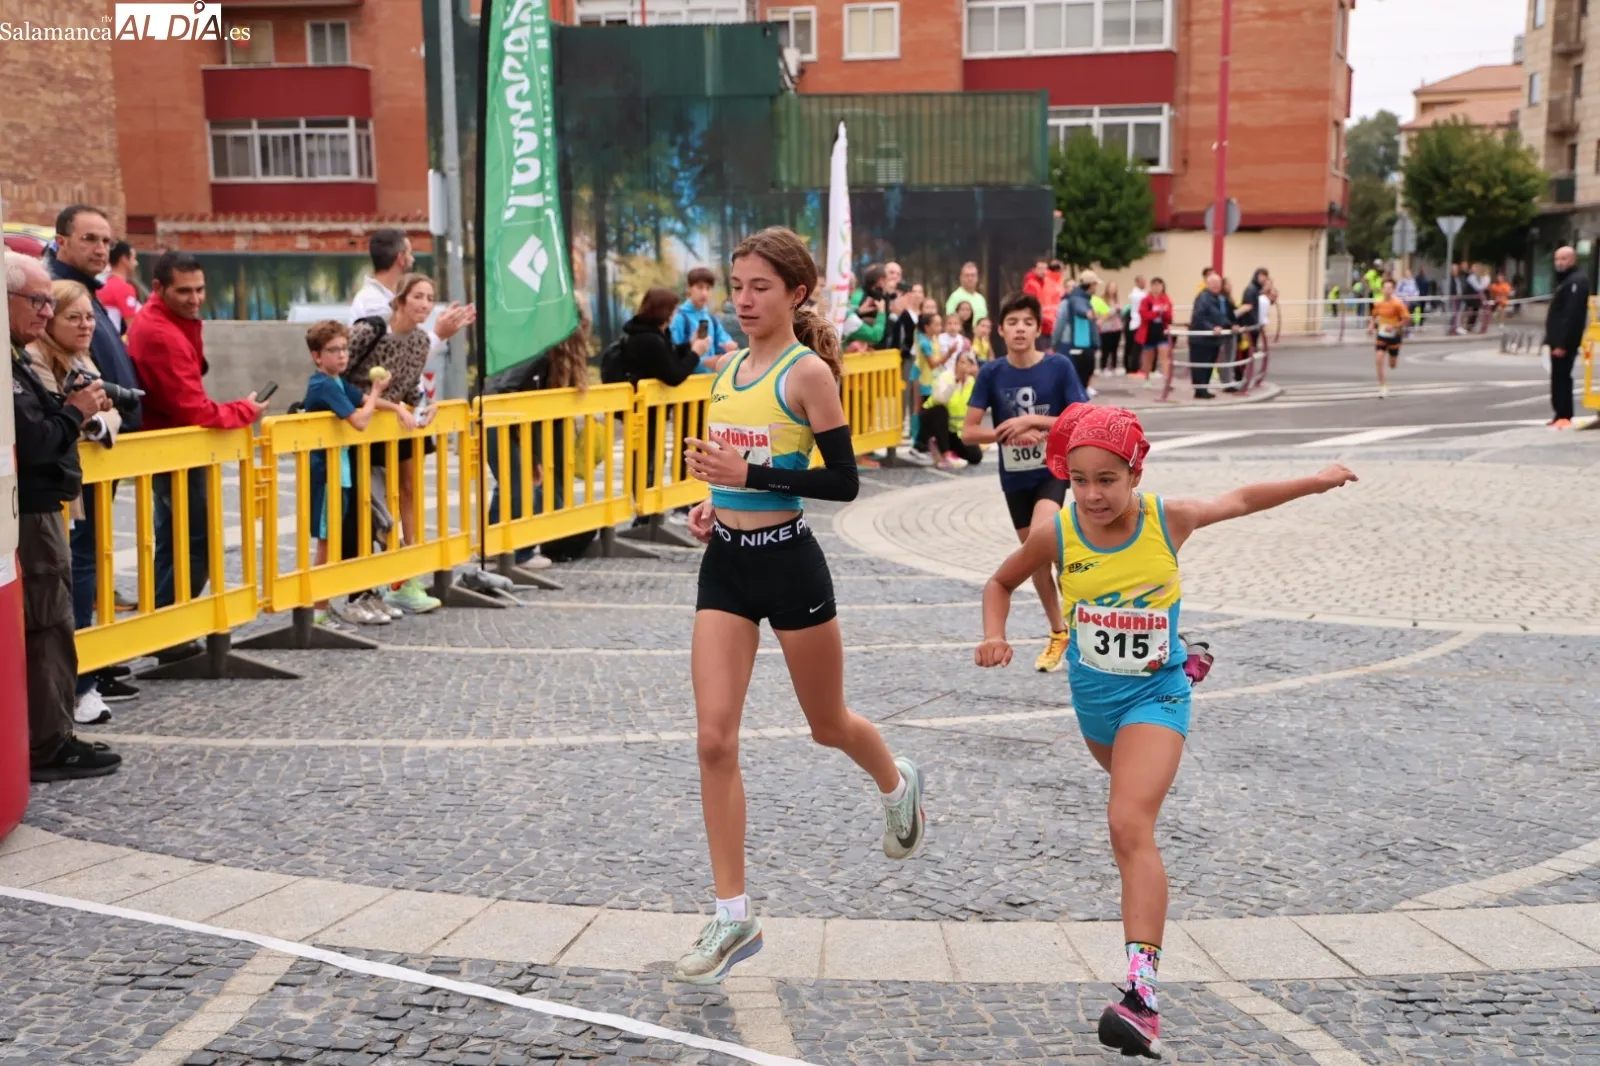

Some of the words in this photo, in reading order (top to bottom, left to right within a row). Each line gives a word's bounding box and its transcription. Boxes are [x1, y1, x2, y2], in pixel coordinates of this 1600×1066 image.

[1012, 446, 1041, 461] 306
[740, 524, 793, 547] NIKE
[1078, 607, 1167, 630] bedunia
[1094, 630, 1149, 659] 315
